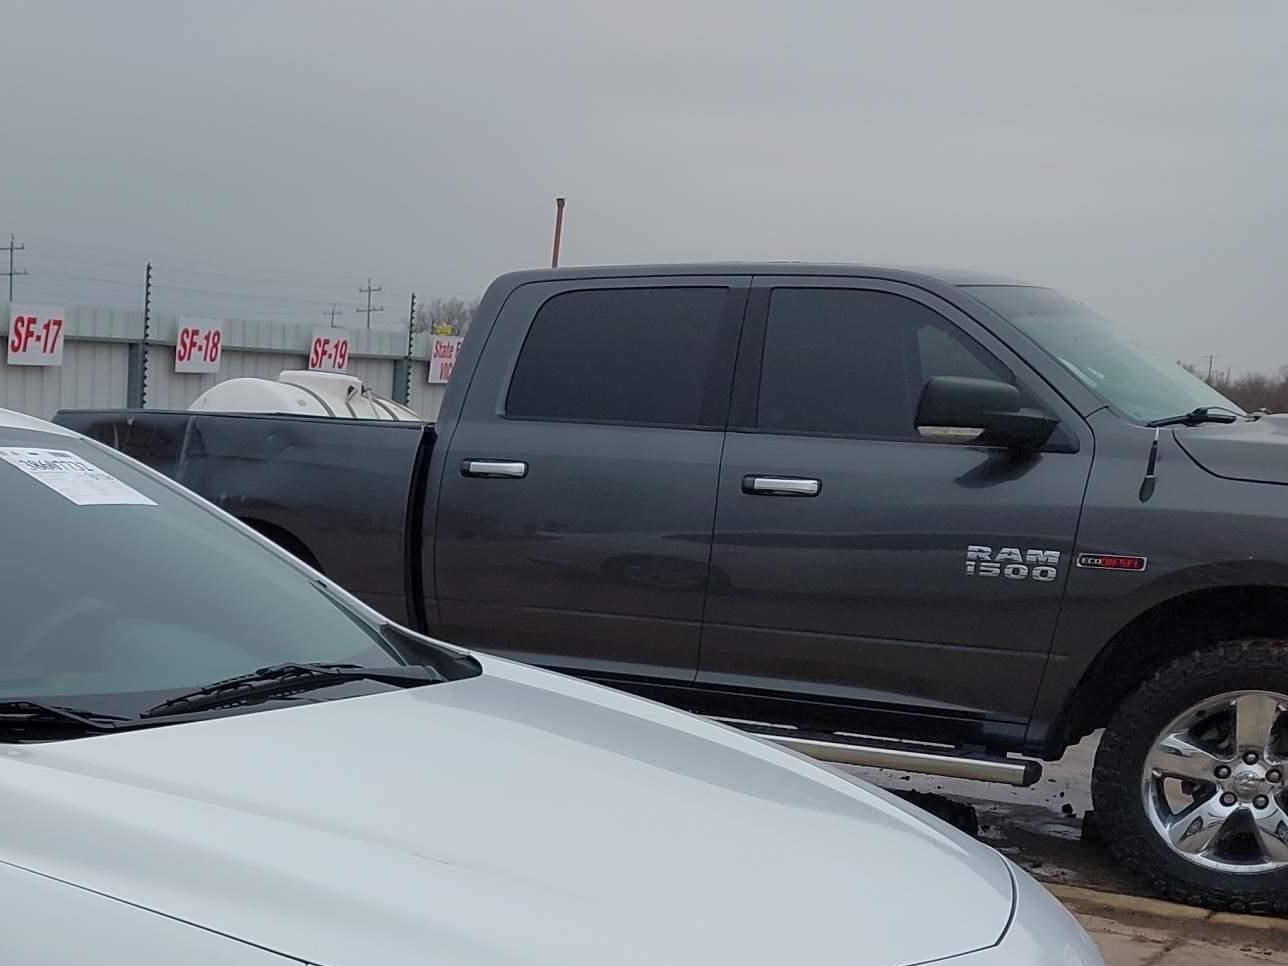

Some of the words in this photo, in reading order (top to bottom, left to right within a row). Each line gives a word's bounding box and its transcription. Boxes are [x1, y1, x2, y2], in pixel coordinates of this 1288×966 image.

[10, 316, 63, 354] SF-17
[177, 329, 220, 361] SF-18
[311, 337, 349, 369] SF-19
[966, 545, 1061, 564] RAM
[965, 561, 1057, 581] 1500
